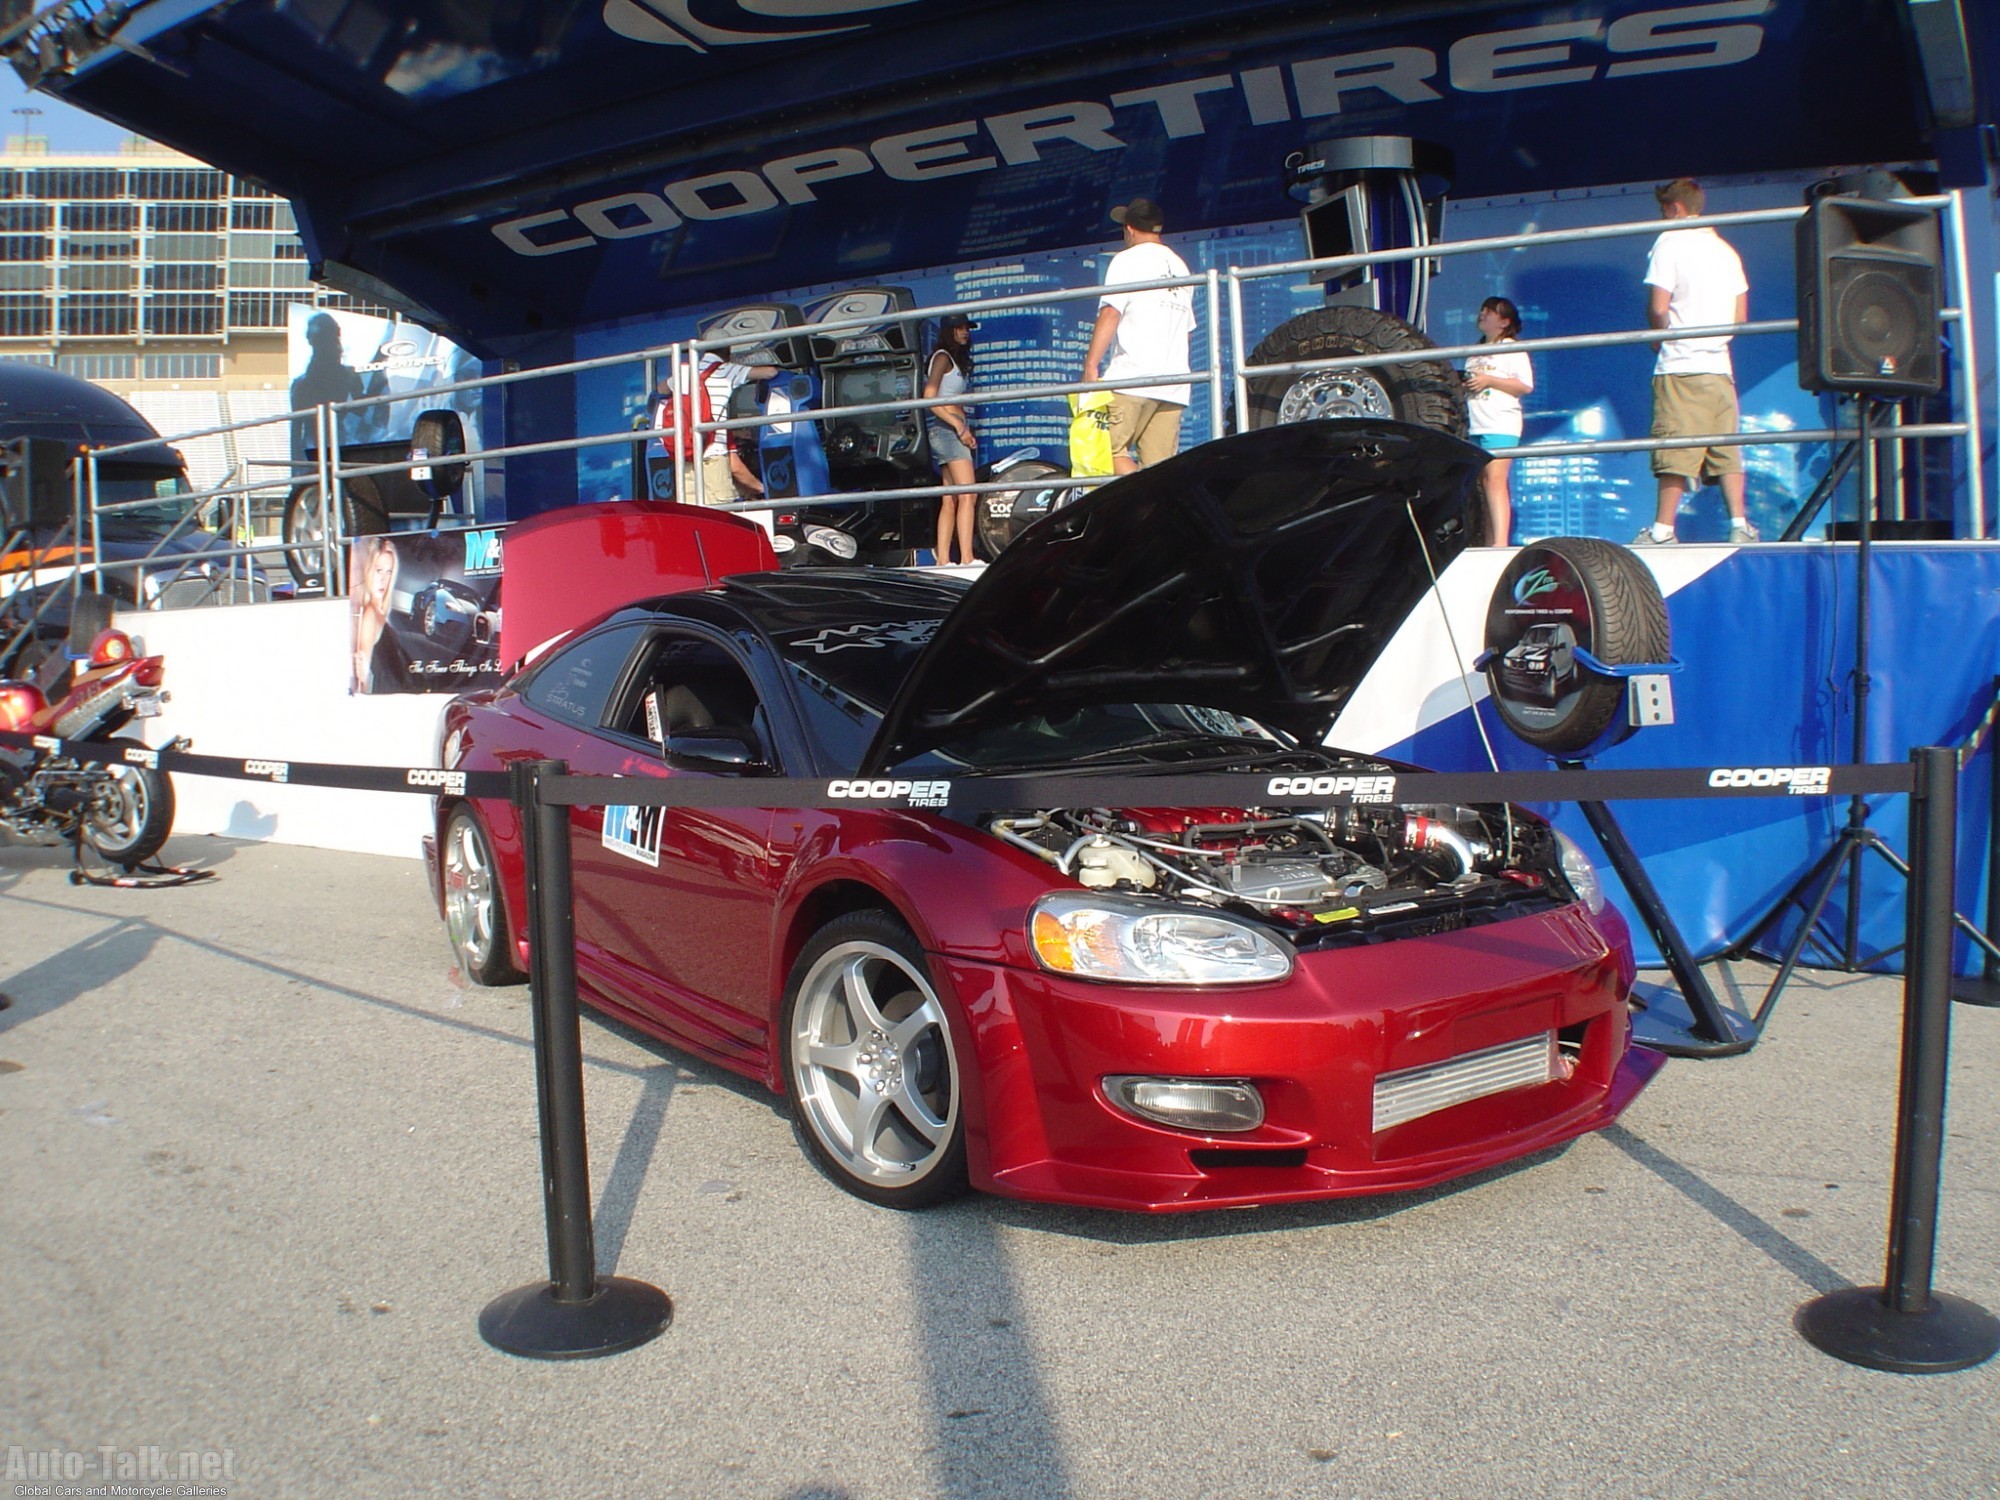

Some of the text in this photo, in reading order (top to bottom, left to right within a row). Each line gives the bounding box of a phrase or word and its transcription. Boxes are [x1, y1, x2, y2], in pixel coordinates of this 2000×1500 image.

[464, 530, 503, 570] M&
[245, 760, 288, 776] COOPER
[407, 769, 467, 788] COOPER
[1708, 766, 1832, 788] COOPER
[444, 786, 465, 796] TIRES
[827, 780, 951, 799] COOPER
[1267, 776, 1397, 796] COOPER
[1787, 785, 1829, 795] TIRES
[907, 798, 949, 808] TIRES
[1350, 794, 1394, 804] TIRES
